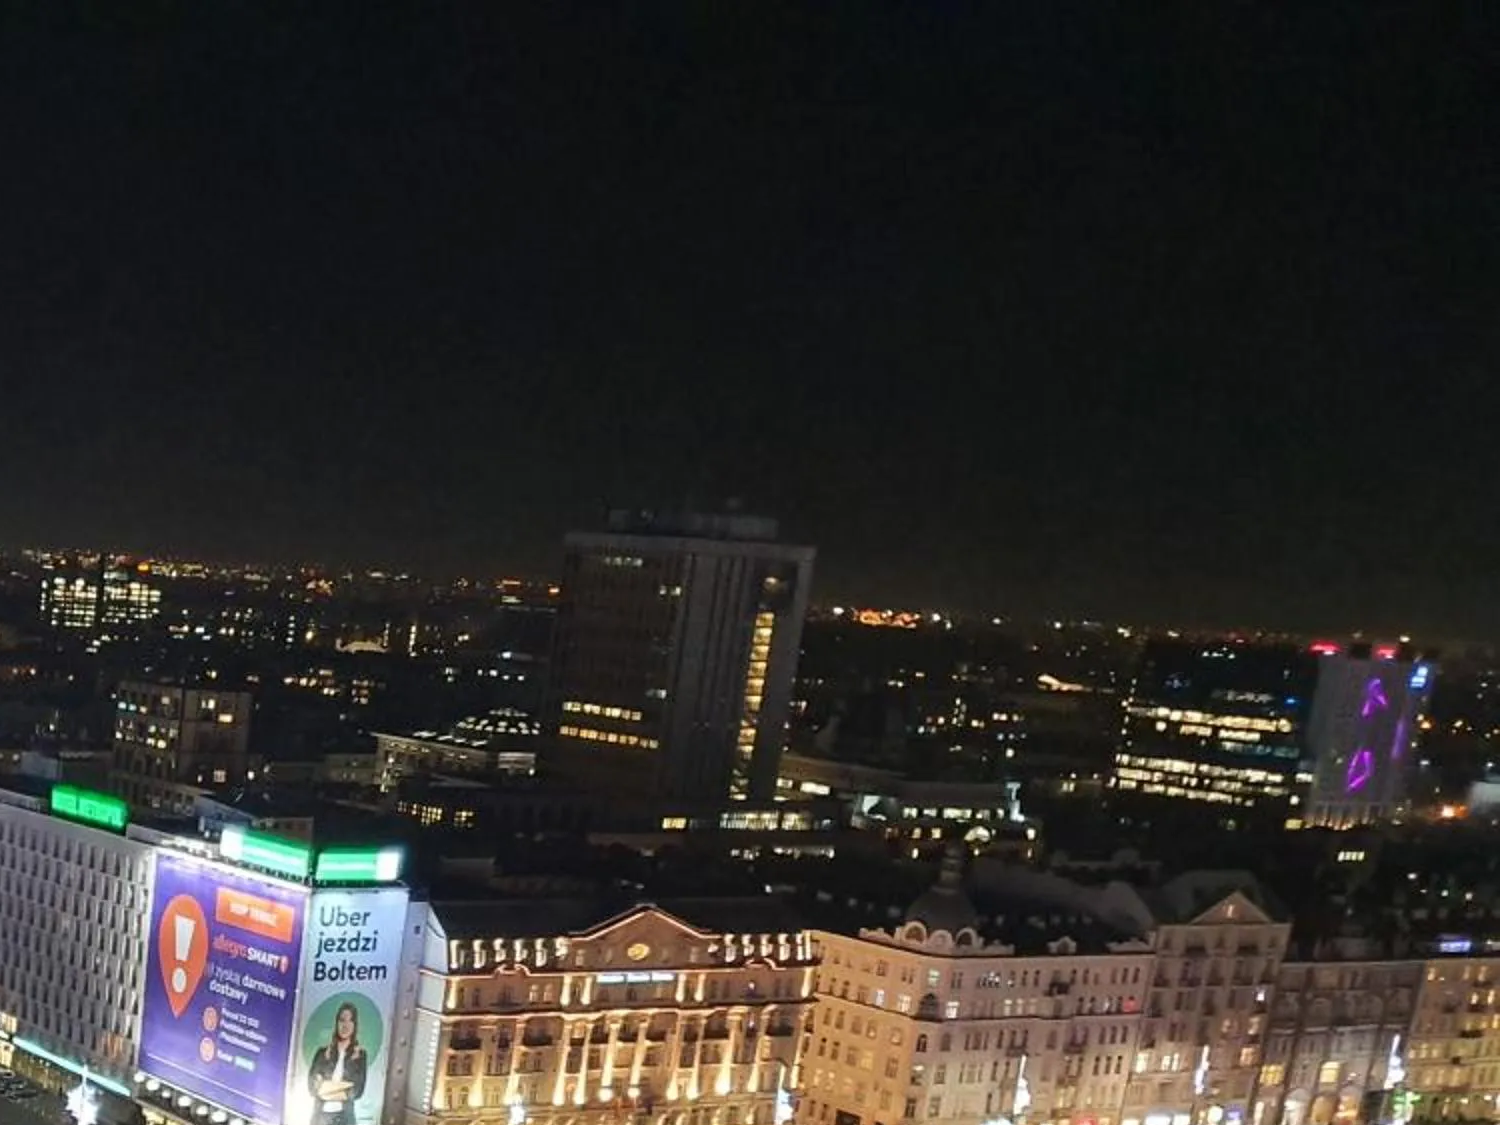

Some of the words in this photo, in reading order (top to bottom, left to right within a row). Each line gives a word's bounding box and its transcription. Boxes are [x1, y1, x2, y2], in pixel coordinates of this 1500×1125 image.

[320, 905, 371, 928] Uber
[315, 930, 379, 958] jeździ
[313, 960, 387, 982] Boltem
